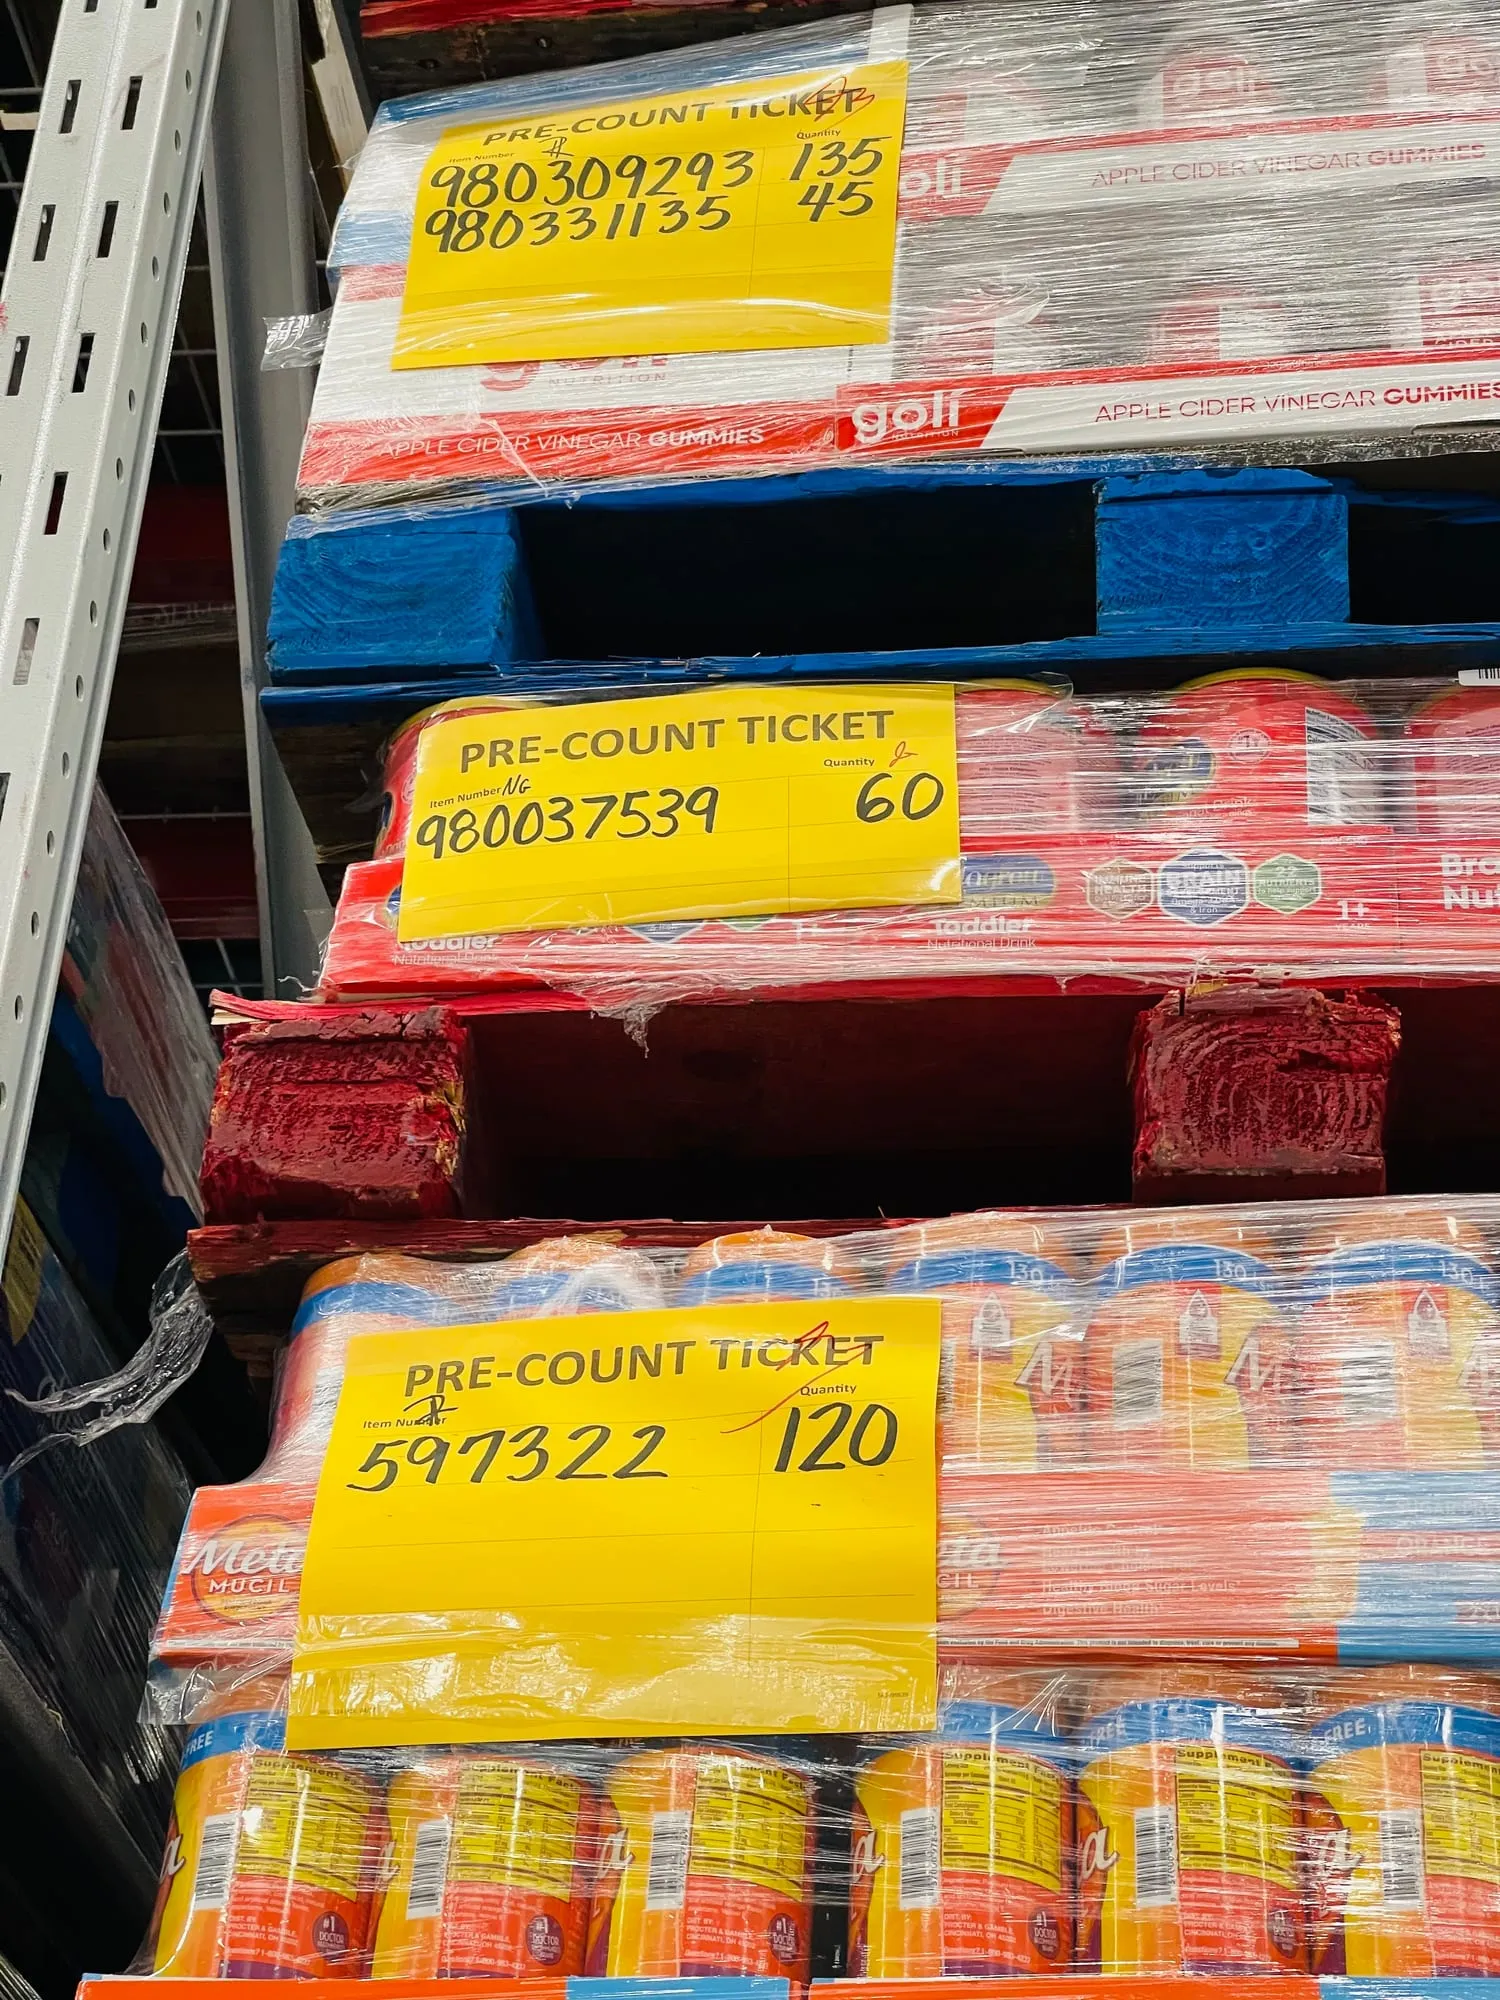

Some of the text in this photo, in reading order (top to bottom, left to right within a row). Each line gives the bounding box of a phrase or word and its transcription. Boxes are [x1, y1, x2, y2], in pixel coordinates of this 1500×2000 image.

[483, 102, 715, 146] PRE-COUNT
[727, 88, 866, 120] TICKET
[796, 128, 841, 140] Quantity
[474, 151, 515, 160] Number
[789, 136, 893, 181] 135
[1091, 143, 1487, 187] APPLE CIDER VINEGAR GUMMIES
[430, 150, 755, 209] 980309293
[901, 156, 964, 198] oli
[798, 181, 874, 223] 45
[425, 194, 732, 253] 980331135
[851, 390, 962, 444] goli
[1095, 403, 1171, 423] APPLE
[1179, 396, 1256, 418] CIDER
[1264, 389, 1376, 414] VINEGAR
[379, 428, 765, 459] APPLE CIDER VINEGAR GUMMIES
[460, 710, 895, 774] PRE-COUNT TICKET
[823, 757, 876, 768] Quantity
[430, 786, 502, 808] Item Number
[856, 772, 945, 823] 60
[416, 786, 719, 860] 980037539
[933, 916, 1035, 936] Toddler
[999, 936, 1036, 949] Drink
[404, 1335, 884, 1397] PRE-COUNT TICKET
[799, 1383, 857, 1397] Quantity
[362, 1416, 448, 1430] Item Nur
[774, 1401, 898, 1474] 120
[346, 1424, 669, 1492] 597322
[939, 1538, 1001, 1571] ta
[208, 1578, 290, 1593] MUCIL
[936, 1573, 980, 1589] CIL
[1324, 1717, 1366, 1739] FREE
[255, 1757, 340, 1780] Supplement
[943, 1751, 1030, 1770] Supplment
[1177, 1750, 1260, 1767] Supplment
[548, 1775, 576, 1789] Fact
[323, 1915, 336, 1932] #1
[319, 1931, 345, 1944] DOCTOR
